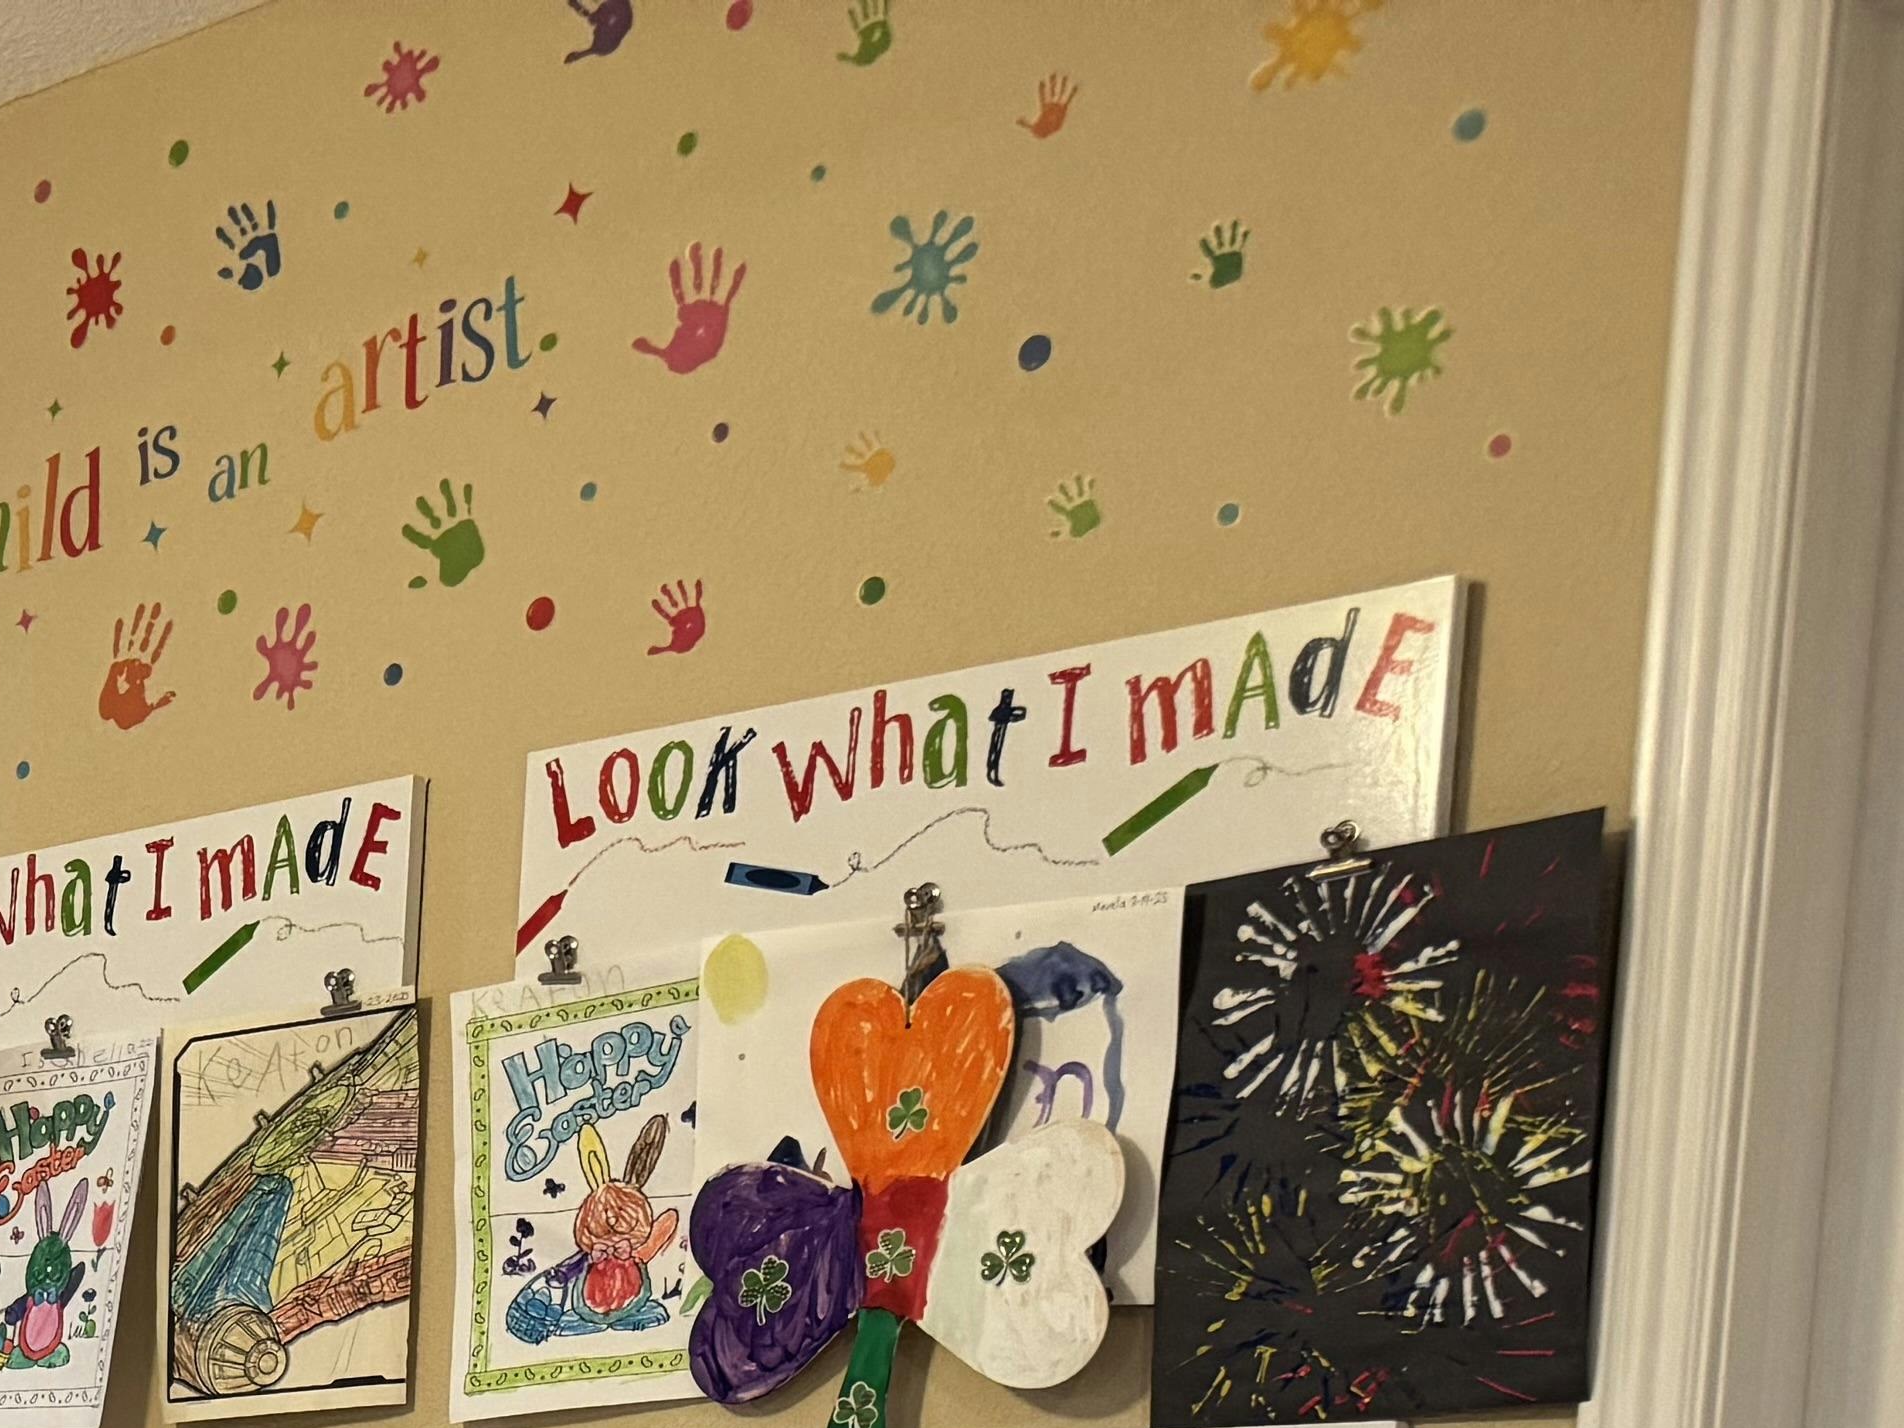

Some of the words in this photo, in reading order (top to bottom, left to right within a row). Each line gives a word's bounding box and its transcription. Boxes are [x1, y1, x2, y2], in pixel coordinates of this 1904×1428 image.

[136, 424, 181, 486] is
[206, 440, 271, 503] an
[1046, 662, 1095, 769] I
[145, 834, 175, 922] I
[500, 1020, 685, 1112] Happy
[504, 1078, 652, 1182] Easter
